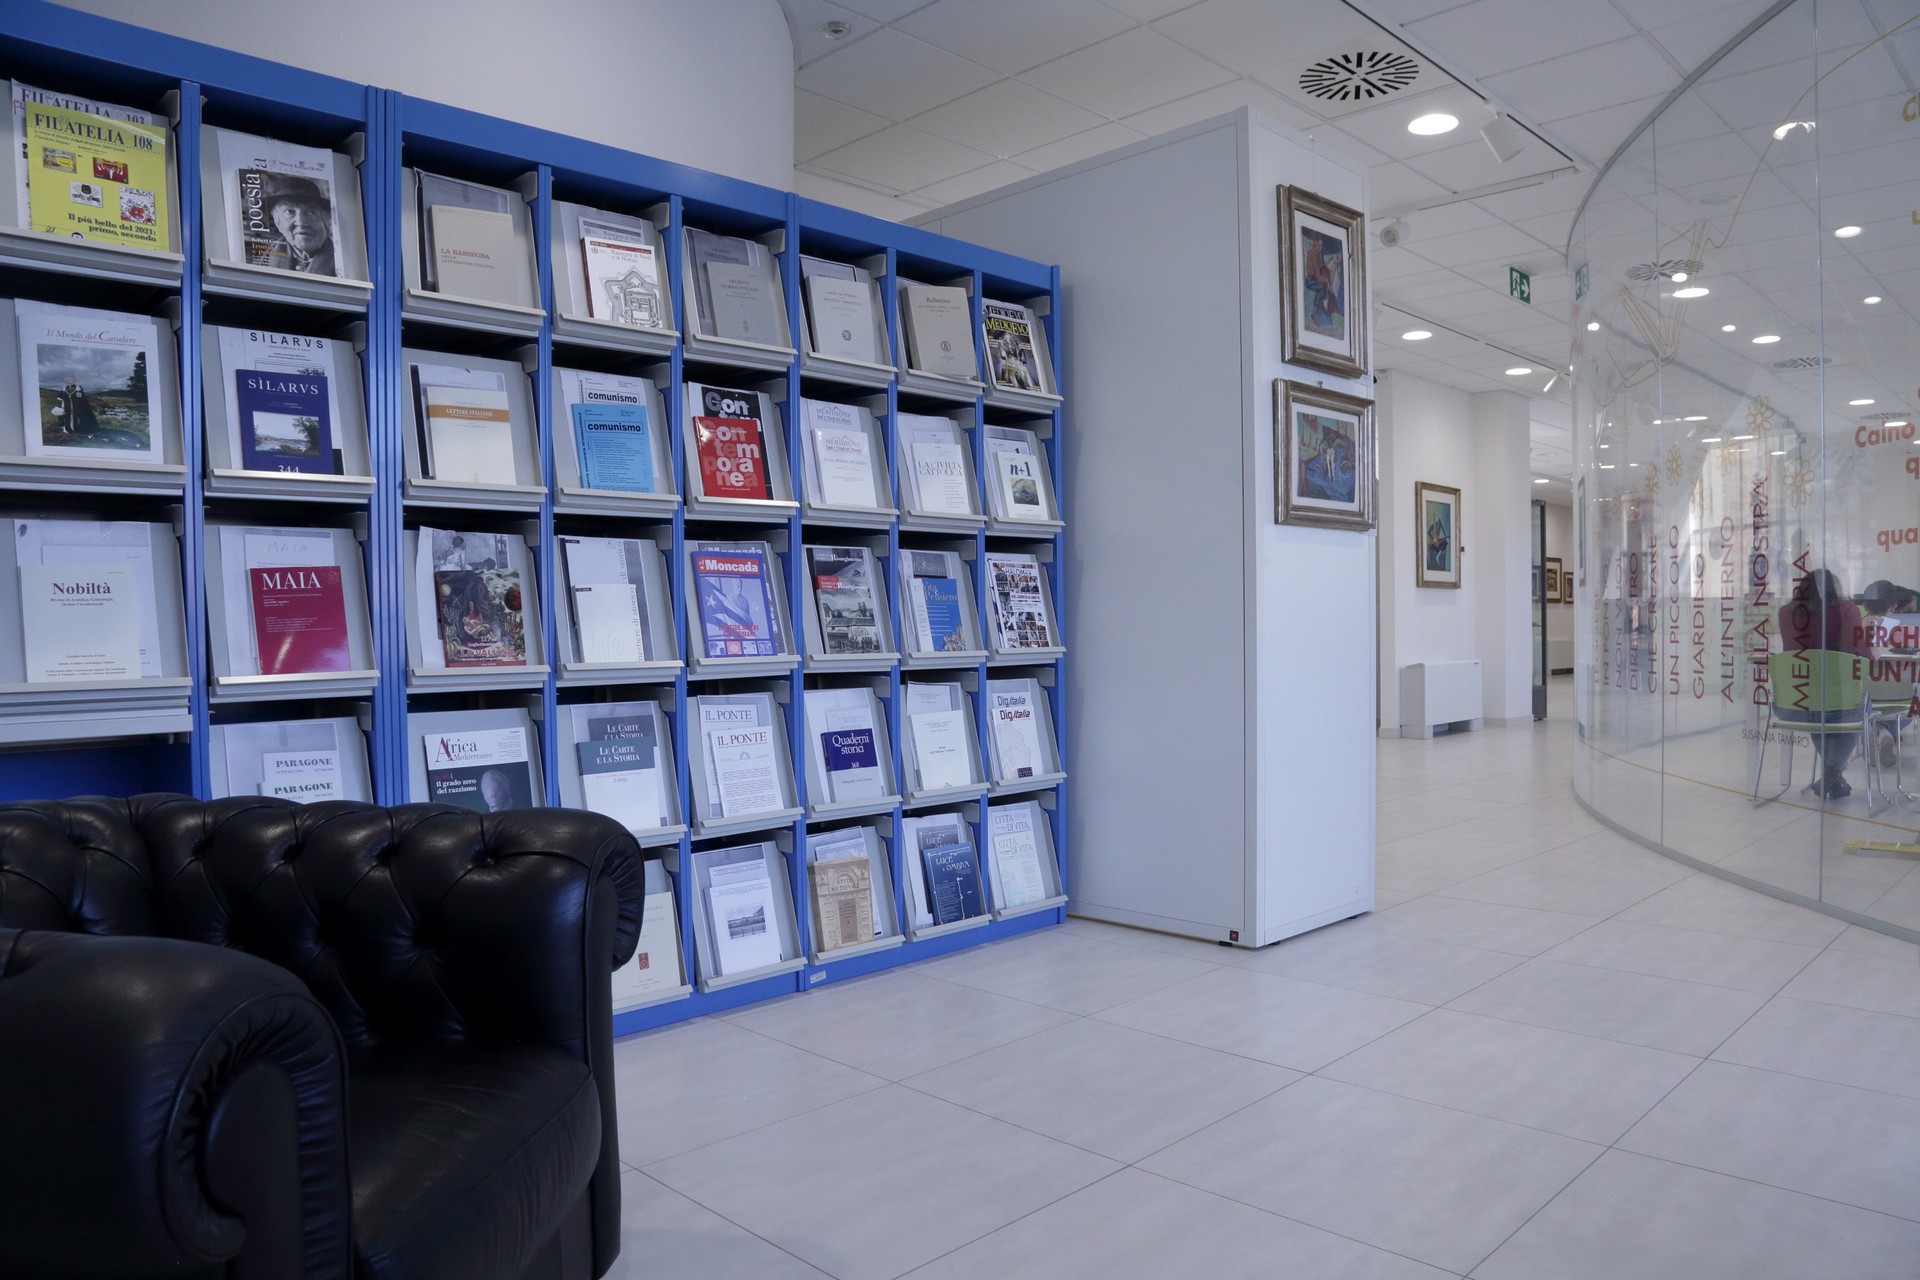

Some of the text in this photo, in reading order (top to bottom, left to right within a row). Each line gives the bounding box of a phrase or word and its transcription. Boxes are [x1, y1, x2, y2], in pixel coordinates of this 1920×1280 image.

[35, 113, 124, 144] FILATELIA
[133, 135, 153, 150] 108
[242, 173, 270, 233] poesia
[77, 215, 93, 225] più
[94, 218, 117, 229] bello
[119, 224, 133, 232] del
[134, 226, 157, 236] 2021:
[88, 225, 157, 242] primo, secondo
[46, 329, 137, 343] Il Mondo del Cavaliere
[986, 318, 1029, 336] MEDIOEVO
[588, 391, 638, 404] comunismo
[705, 392, 749, 416] Con
[588, 423, 641, 432] comunismo
[1854, 420, 1916, 448] Caino
[714, 439, 759, 458] tem
[703, 456, 754, 475] pora
[1010, 461, 1032, 477] n+1
[716, 471, 758, 487] nea
[704, 559, 759, 573] Moncada
[52, 582, 111, 595] Nobiltà
[261, 571, 323, 591] MAIA
[1753, 476, 1769, 706] DELLA NOSTRA
[1648, 535, 1657, 694] CHE CREARE
[1669, 525, 1680, 695] UN PICCOLO
[1720, 516, 1734, 703] ALL'INTERNO
[1693, 553, 1705, 699] GIARDINO
[1792, 542, 1810, 711] MEMORIA.
[1852, 625, 1920, 649] PERCH
[1630, 644, 1638, 690] DIRE
[705, 710, 753, 720] IL PONTE
[717, 732, 767, 746] IL PONTE
[832, 732, 869, 747] Quaderni
[1742, 728, 1809, 748] SUSANNA TAMARO
[435, 737, 477, 762] Africa
[453, 753, 493, 761] Mediterraneo
[276, 758, 333, 768] PARAGONE
[274, 782, 333, 795] PARAGONE
[443, 780, 462, 788] grado
